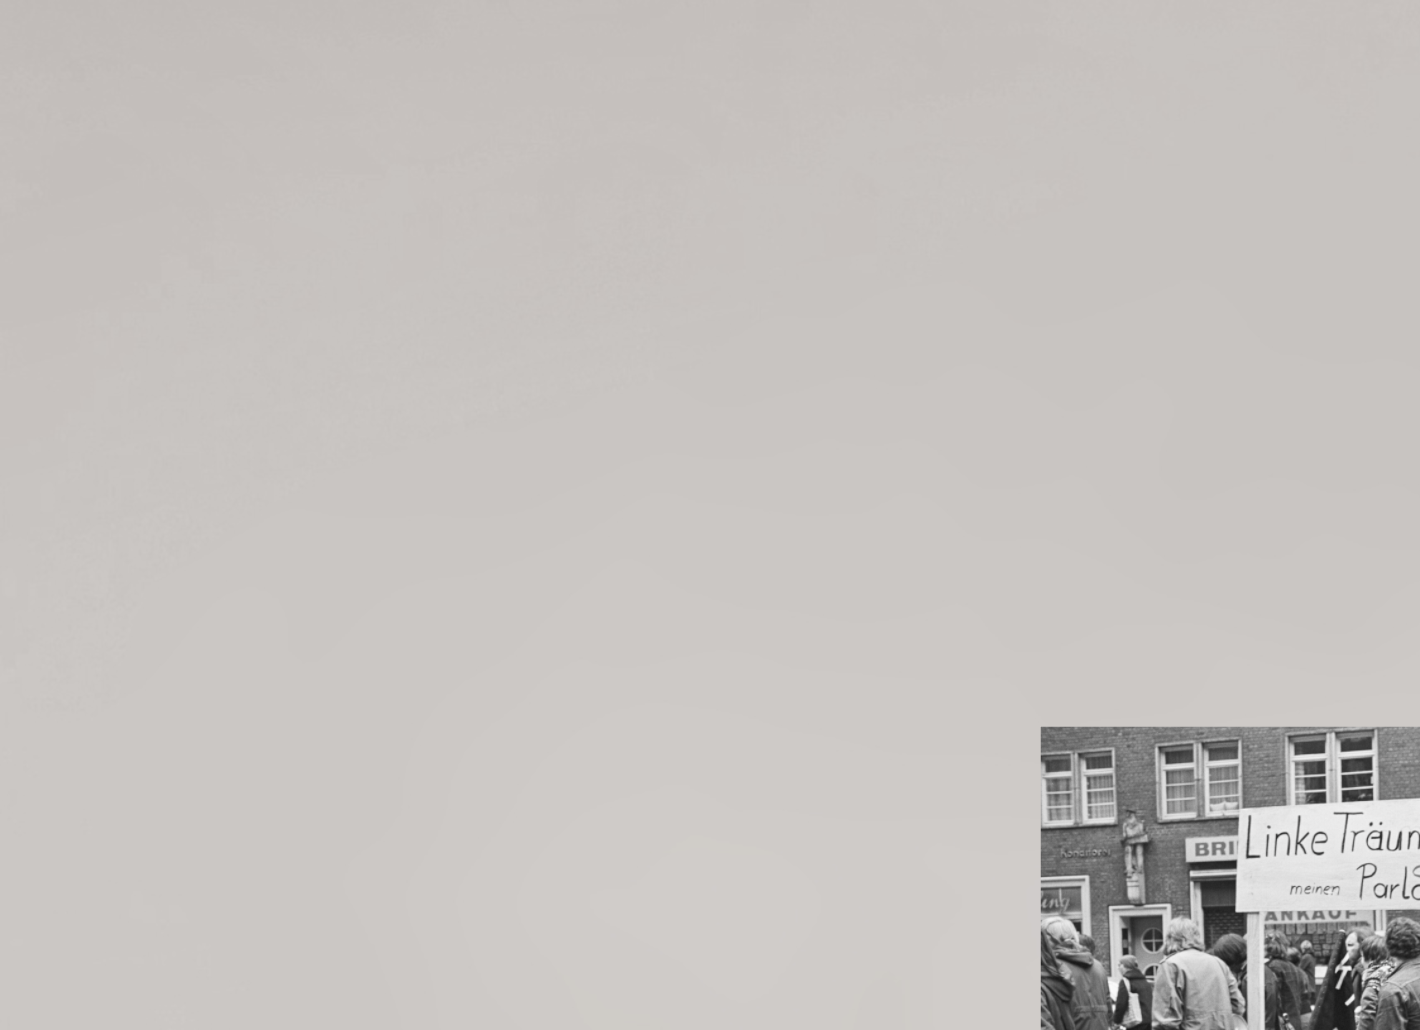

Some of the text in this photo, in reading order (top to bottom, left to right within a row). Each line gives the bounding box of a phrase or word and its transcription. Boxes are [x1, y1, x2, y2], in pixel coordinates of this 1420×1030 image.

[1246, 814, 1329, 859] Linke
[1194, 841, 1239, 857] BRI
[1289, 883, 1341, 896] meinen
